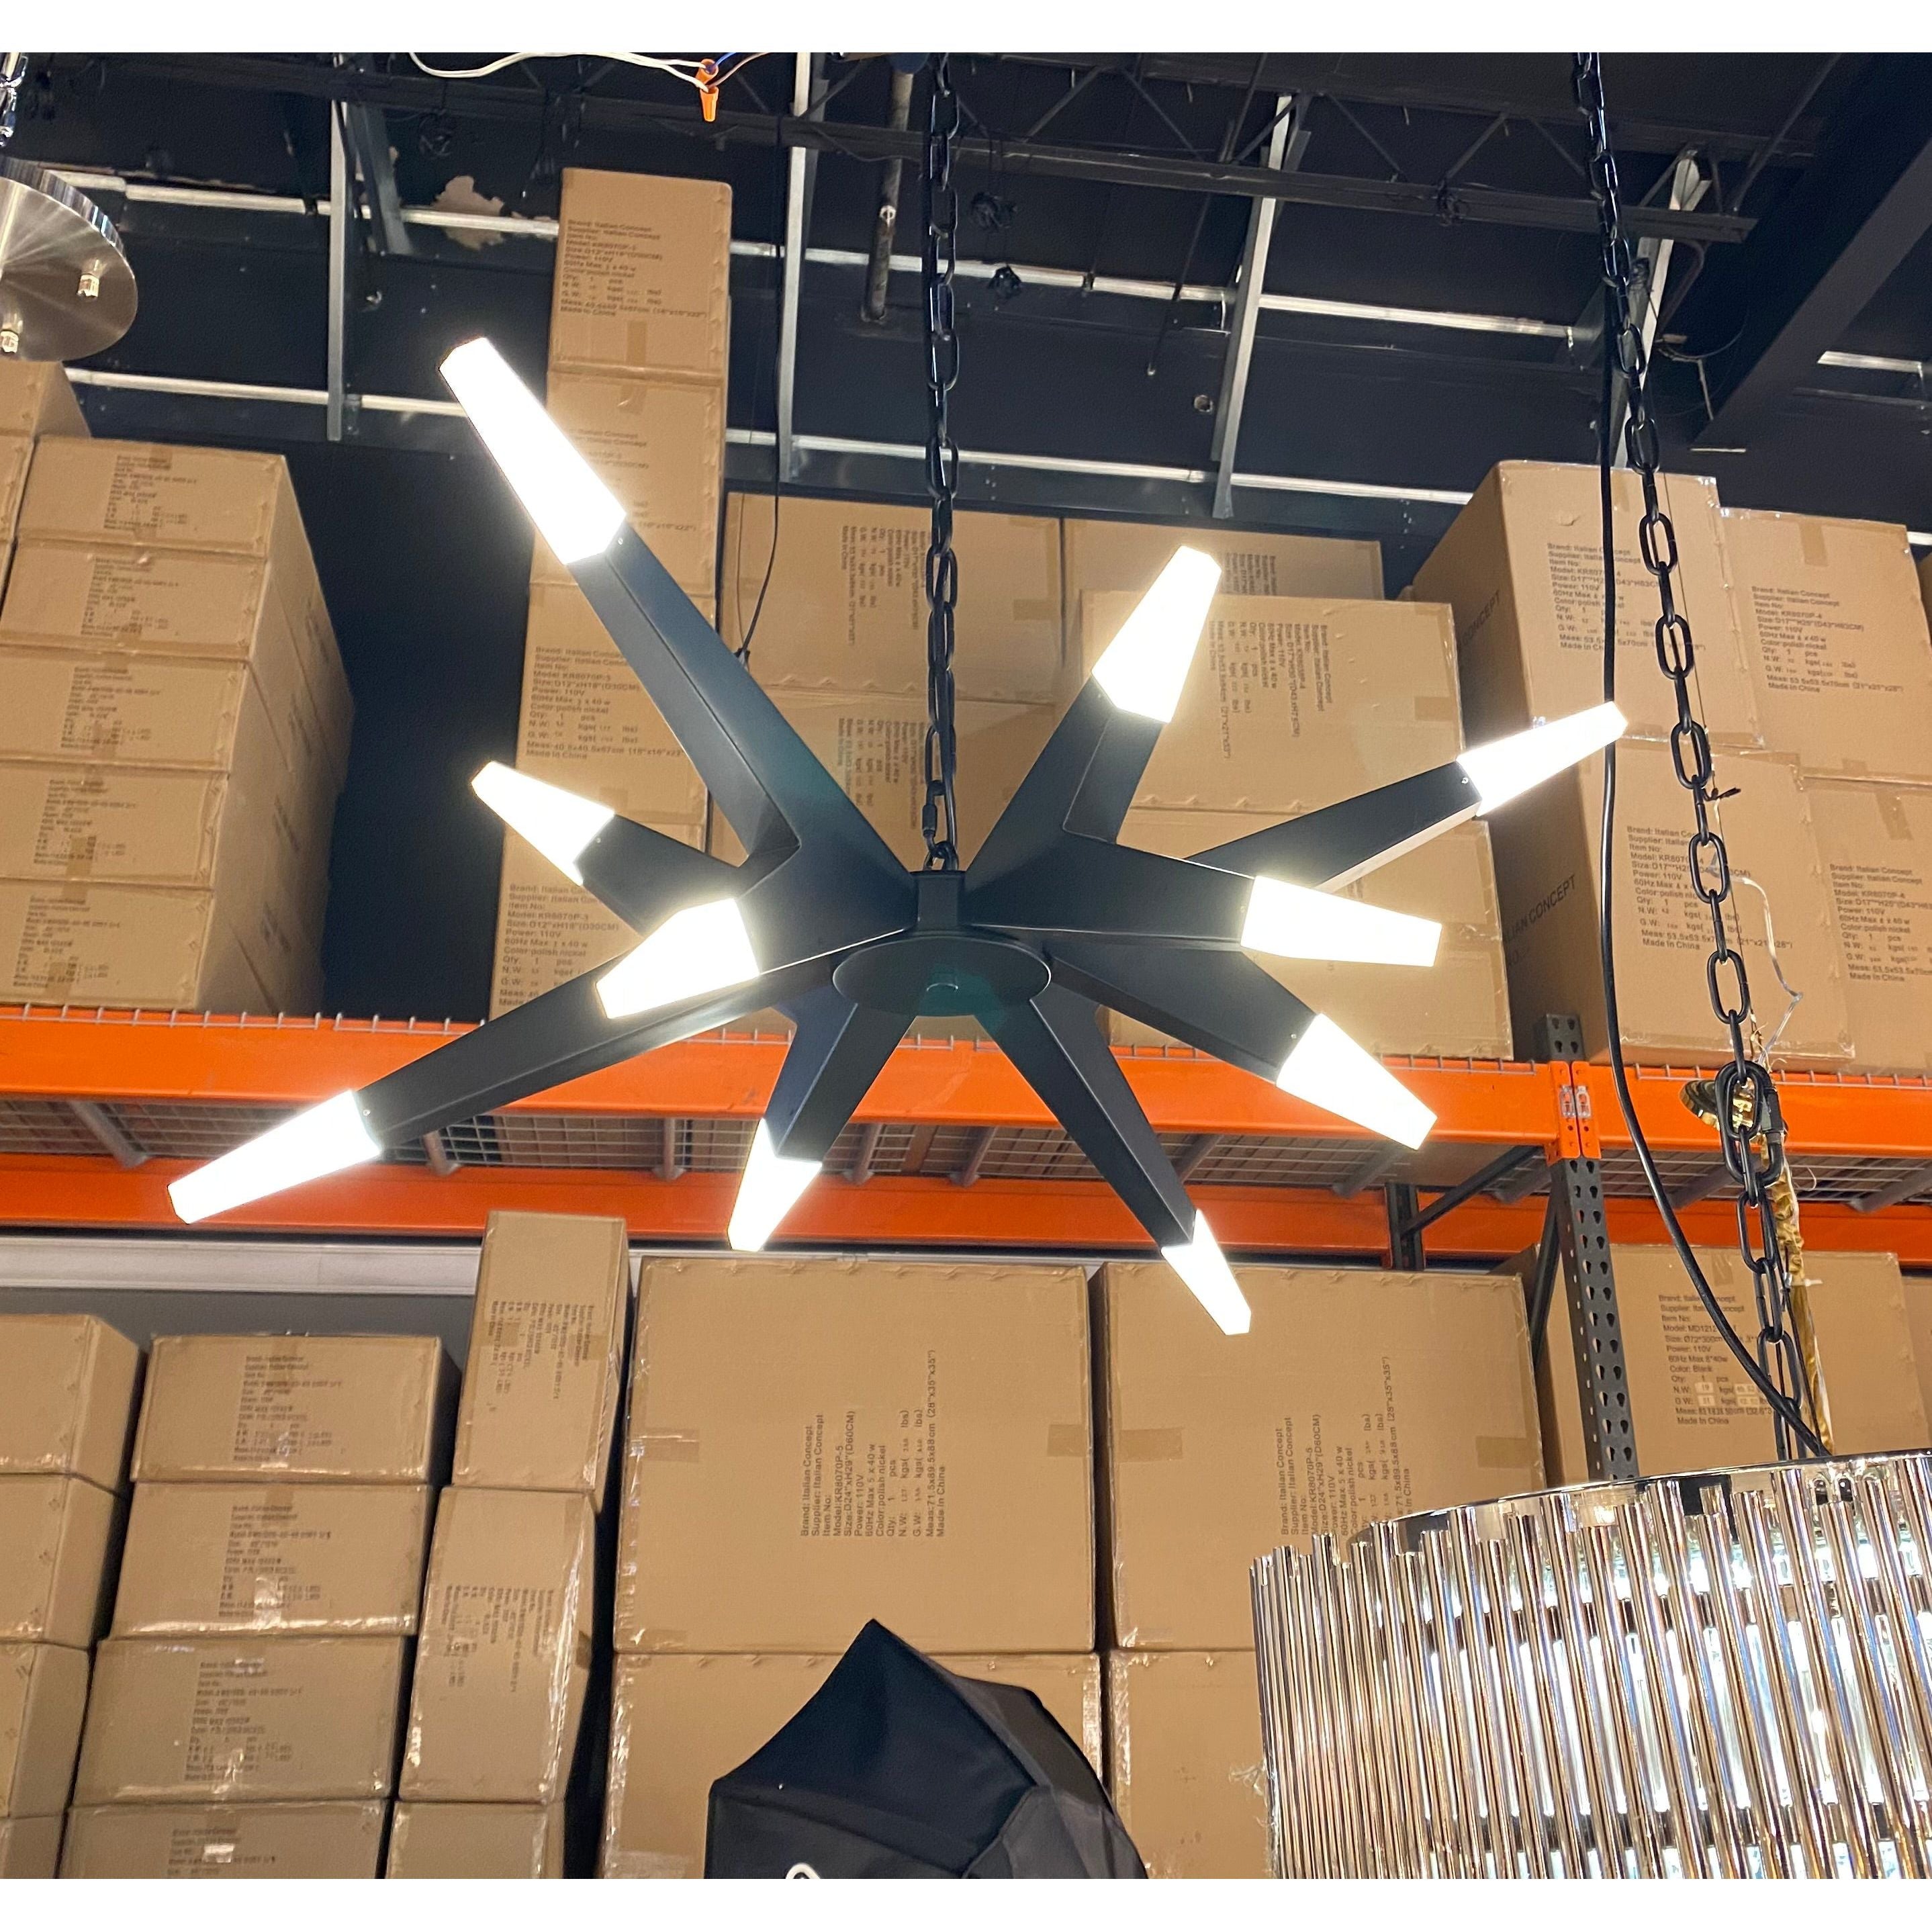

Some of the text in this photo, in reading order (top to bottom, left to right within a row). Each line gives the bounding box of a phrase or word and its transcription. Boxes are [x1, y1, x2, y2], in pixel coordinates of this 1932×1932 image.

[1547, 543, 1571, 551] Brand:
[1600, 547, 1630, 555] Ccept
[1549, 551, 1583, 559] Supplier:
[1613, 556, 1641, 564] oncept
[1801, 590, 1830, 598] Concept
[1810, 598, 1839, 607] Concept
[1628, 835, 1662, 844] Supplier:
[1663, 872, 1682, 880] 110V
[1528, 874, 1575, 923] CONCEPT
[1643, 938, 1664, 946] Made
[1677, 941, 1700, 950] China
[803, 1426, 813, 1467] Concept
[1285, 1418, 1294, 1457] Concept
[1336, 1457, 1344, 1467] 40
[1346, 1448, 1354, 1475] nickel
[1357, 1462, 1365, 1478] pcs
[812, 1415, 824, 1536] Supplier: Italian Concept
[937, 1467, 945, 1494] China
[1276, 1428, 1289, 1534] Brand: Italian Concept
[1328, 1476, 1336, 1498] 110V
[1402, 1469, 1412, 1496] China
[801, 1503, 809, 1536] Brand:
[823, 1514, 831, 1536] Item
[937, 1509, 945, 1536] Made
[1290, 1492, 1299, 1534] Supplier:
